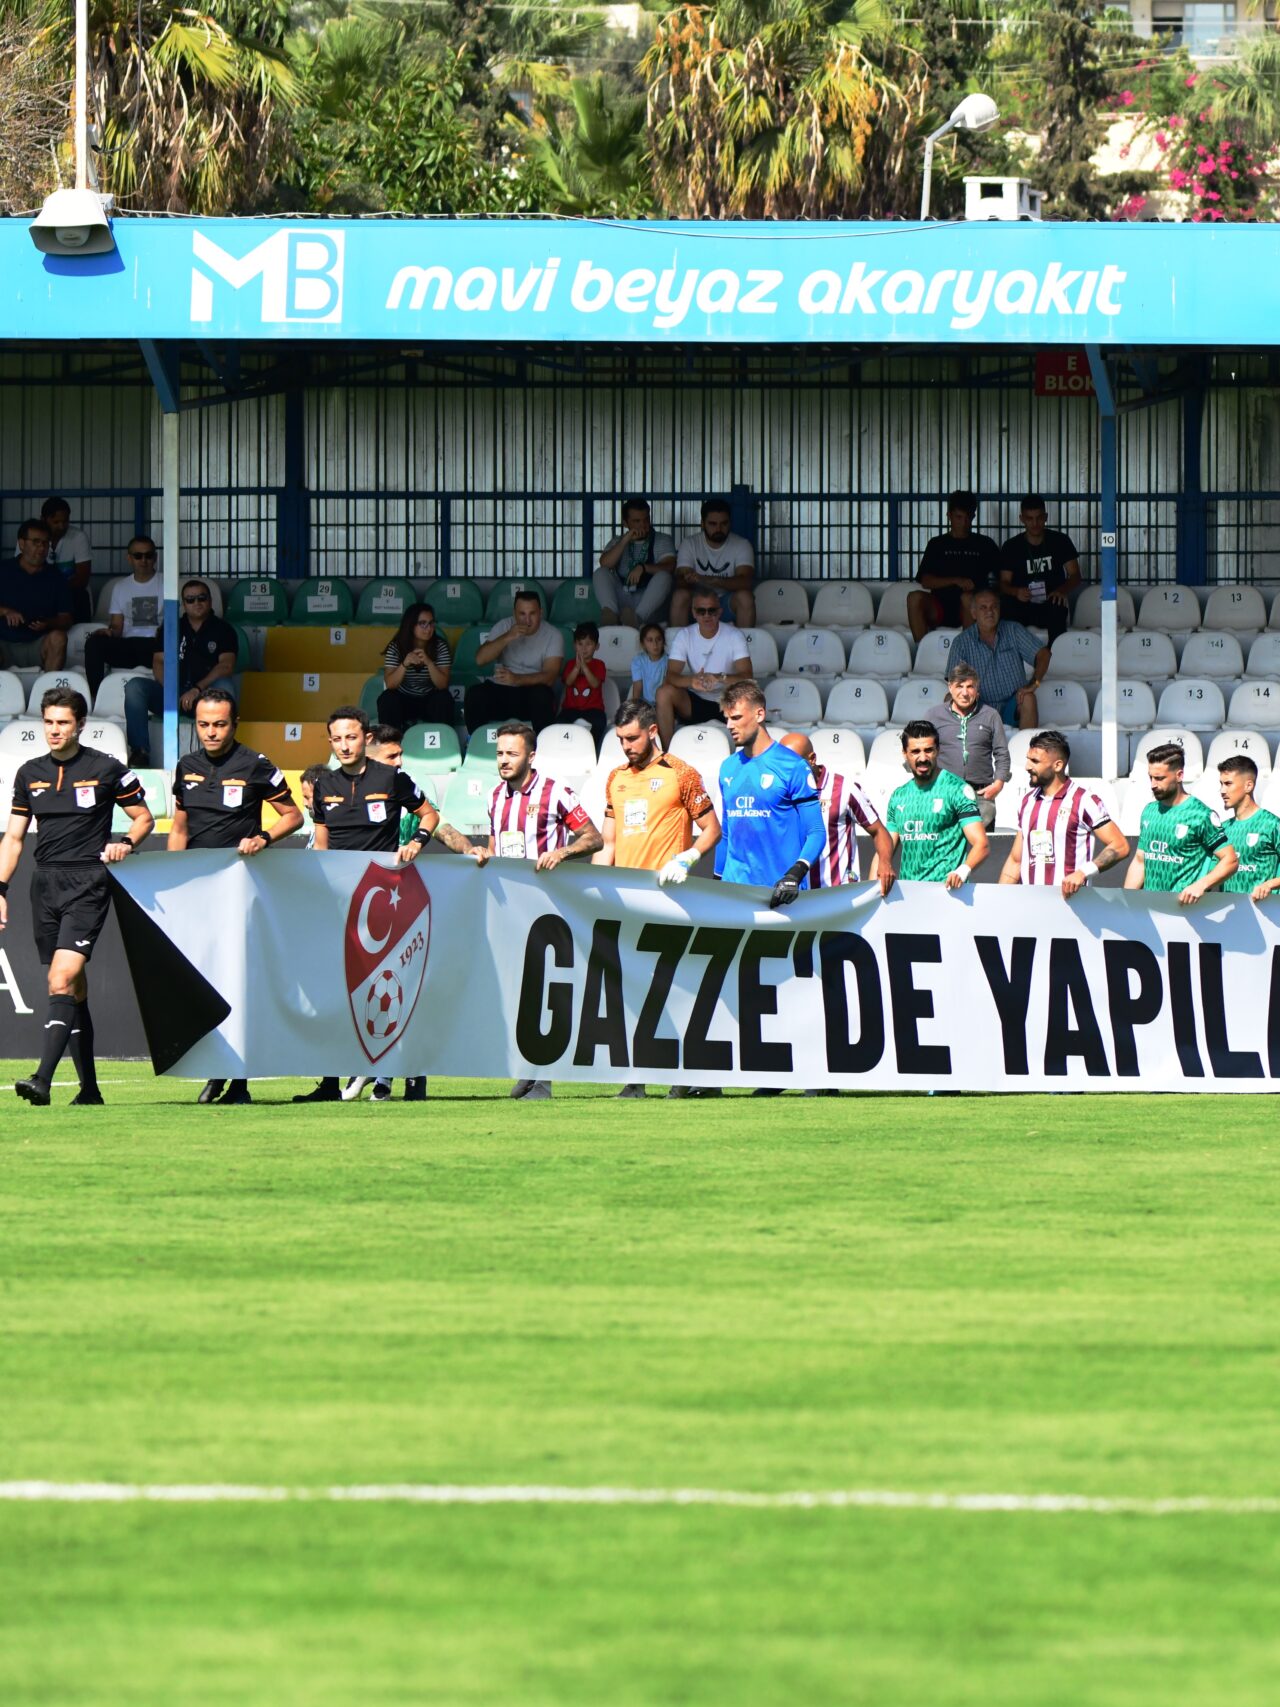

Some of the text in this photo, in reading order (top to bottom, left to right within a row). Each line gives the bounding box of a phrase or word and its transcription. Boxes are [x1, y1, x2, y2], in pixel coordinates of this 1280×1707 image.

[190, 228, 345, 323] MB
[385, 257, 1128, 330] mavi beyaz akaryakıt
[1067, 356, 1078, 371] E
[1044, 375, 1097, 391] BLOK
[1102, 535, 1115, 545] 10
[251, 583, 267, 594] 28
[319, 585, 330, 594] 29
[383, 588, 394, 597] 30
[579, 587, 585, 596] 3
[778, 588, 784, 597] 6
[840, 586, 847, 595] 7
[1163, 592, 1180, 604] 12
[1231, 593, 1242, 603] 13
[334, 630, 342, 641] 6
[613, 636, 619, 646] 4
[811, 635, 818, 646] 7
[877, 635, 885, 646] 8
[943, 638, 950, 649] 9
[1141, 638, 1152, 647] 13
[55, 678, 69, 689] 26
[307, 676, 315, 687] 5
[452, 689, 460, 700] 2
[788, 686, 795, 696] 7
[854, 687, 861, 698] 8
[922, 686, 929, 696] 9
[1054, 688, 1063, 697] 11
[1122, 688, 1133, 697] 12
[1188, 689, 1203, 699] 13
[1255, 688, 1270, 698] 14
[21, 729, 35, 742] 26
[92, 729, 104, 740] 27
[289, 727, 297, 738] 4
[491, 732, 497, 741] 3
[563, 731, 570, 741] 4
[428, 735, 436, 746] 2
[833, 734, 840, 744] 8
[1234, 739, 1249, 750] 14
[735, 796, 755, 809] CIP
[904, 820, 924, 832] CIP
[1149, 840, 1168, 853] CIP
[1238, 864, 1257, 872] ENCY
[400, 931, 425, 968] 1923
[516, 913, 952, 1075] GAZZE'DE
